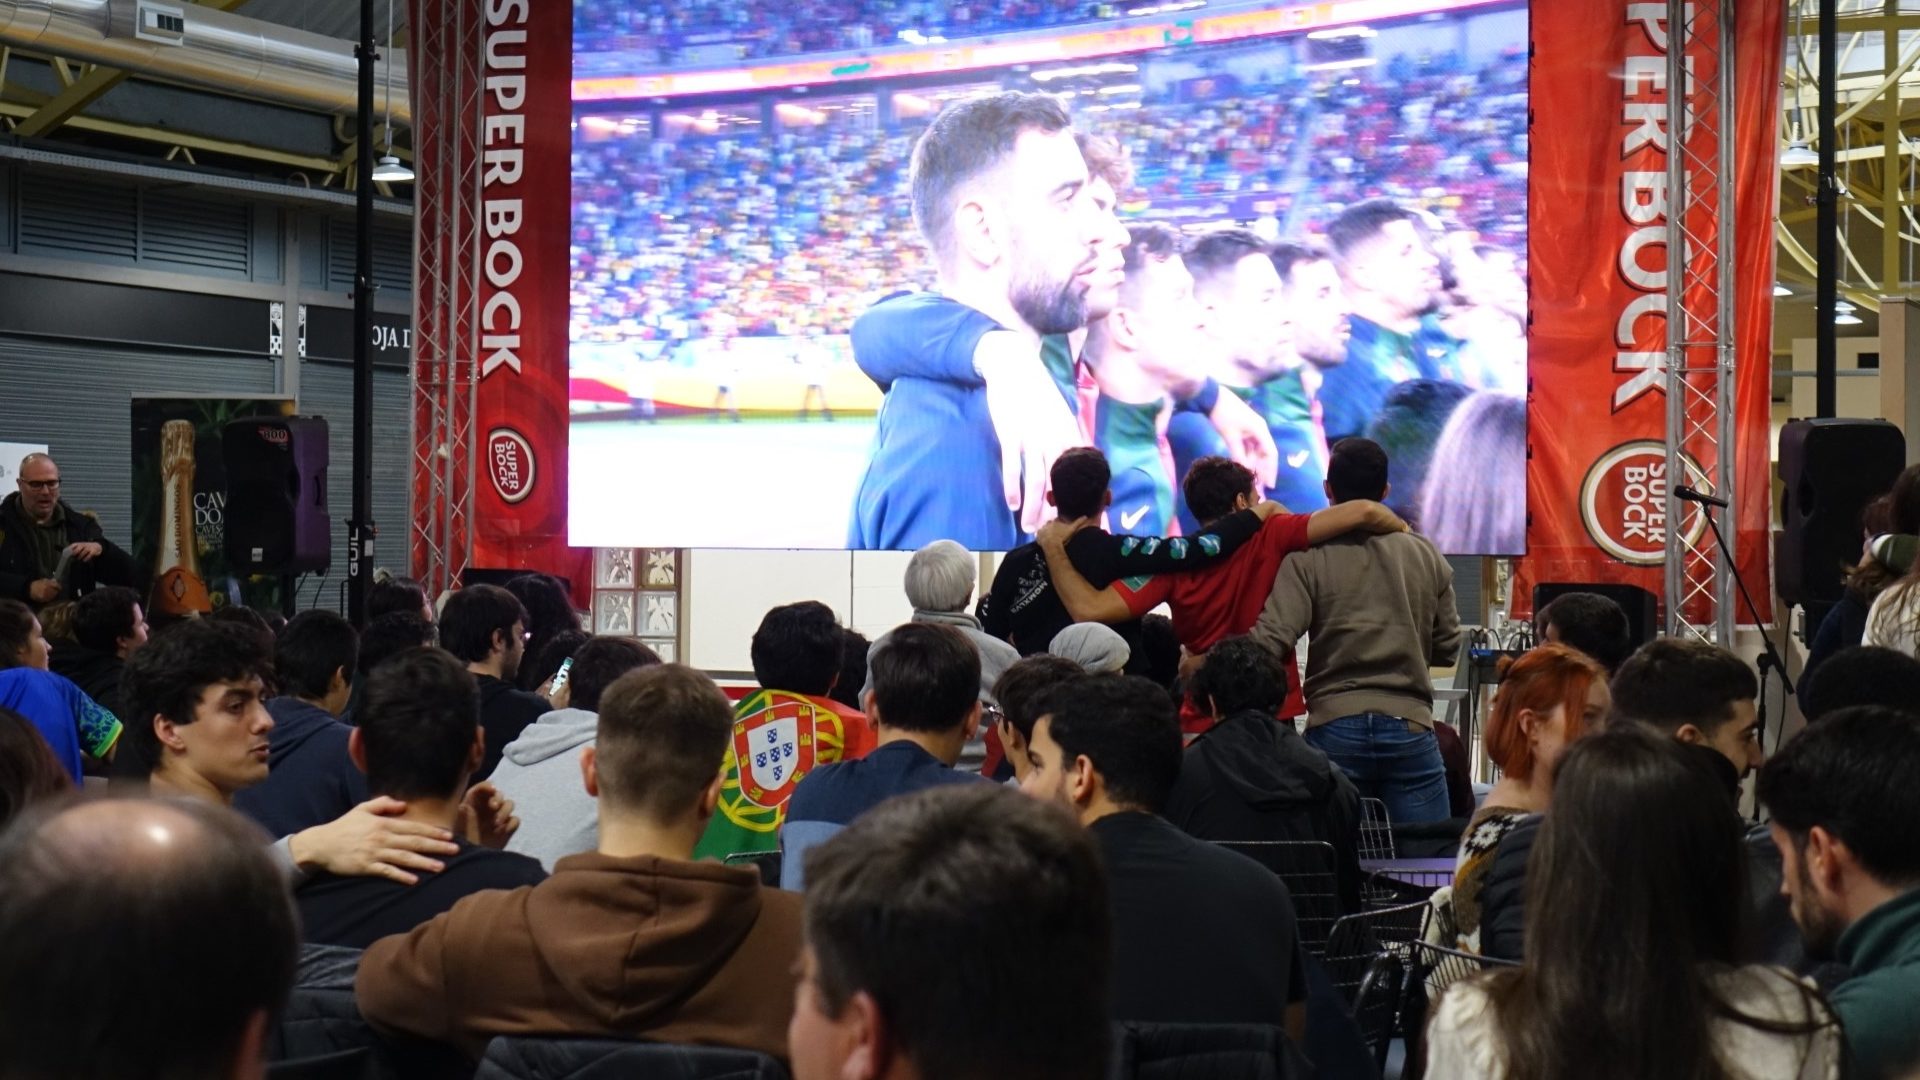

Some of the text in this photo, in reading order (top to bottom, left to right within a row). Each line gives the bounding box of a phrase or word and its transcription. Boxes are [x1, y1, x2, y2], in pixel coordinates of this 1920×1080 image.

[482, 0, 528, 377] SUPER BOCK
[1615, 171, 1693, 406] BOCK
[495, 443, 509, 488] BOCK
[505, 441, 519, 490] SUPER
[195, 508, 224, 526] DO
[1623, 467, 1648, 540] BOCK
[1648, 462, 1666, 544] SUPER
[350, 527, 359, 577] GUIL
